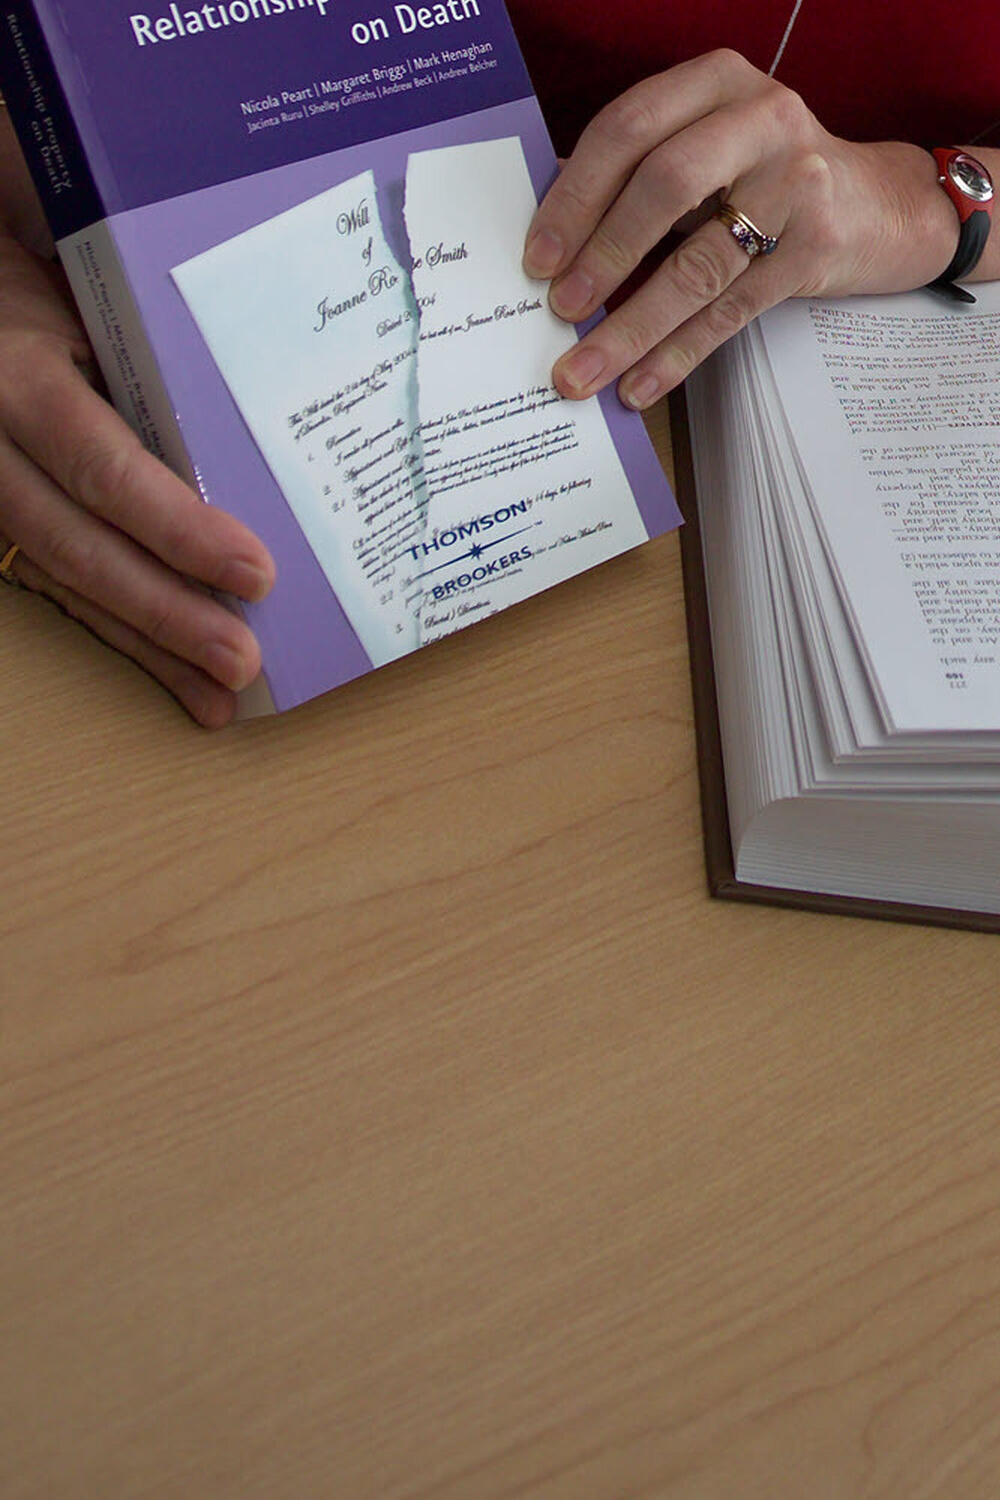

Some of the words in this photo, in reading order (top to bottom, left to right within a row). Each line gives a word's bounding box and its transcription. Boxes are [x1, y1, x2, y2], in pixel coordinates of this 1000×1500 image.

[351, 15, 389, 44] on
[7, 13, 46, 113] Relationship
[44, 116, 72, 189] Property
[240, 95, 280, 115] Nicola
[281, 87, 313, 104] Peart
[321, 73, 371, 93] Margaret
[372, 64, 407, 81] Briggs
[413, 53, 441, 70] Mark
[441, 42, 493, 61] Henaghan
[247, 117, 280, 134] Jacinta
[280, 110, 303, 122] Ruru
[308, 100, 340, 116] Shelley
[341, 89, 377, 106] Griffiths
[382, 80, 413, 95] Andrew
[413, 74, 433, 87] Beck
[439, 67, 468, 80] Andrew
[469, 60, 498, 73] Belcher
[31, 120, 43, 141] on
[40, 146, 62, 194] Death
[337, 198, 370, 236] Will
[361, 236, 374, 267] of
[426, 242, 468, 270] Smith
[313, 290, 367, 332] Joanne
[405, 499, 528, 561] THOMSON
[431, 545, 533, 601] BROOKERS
